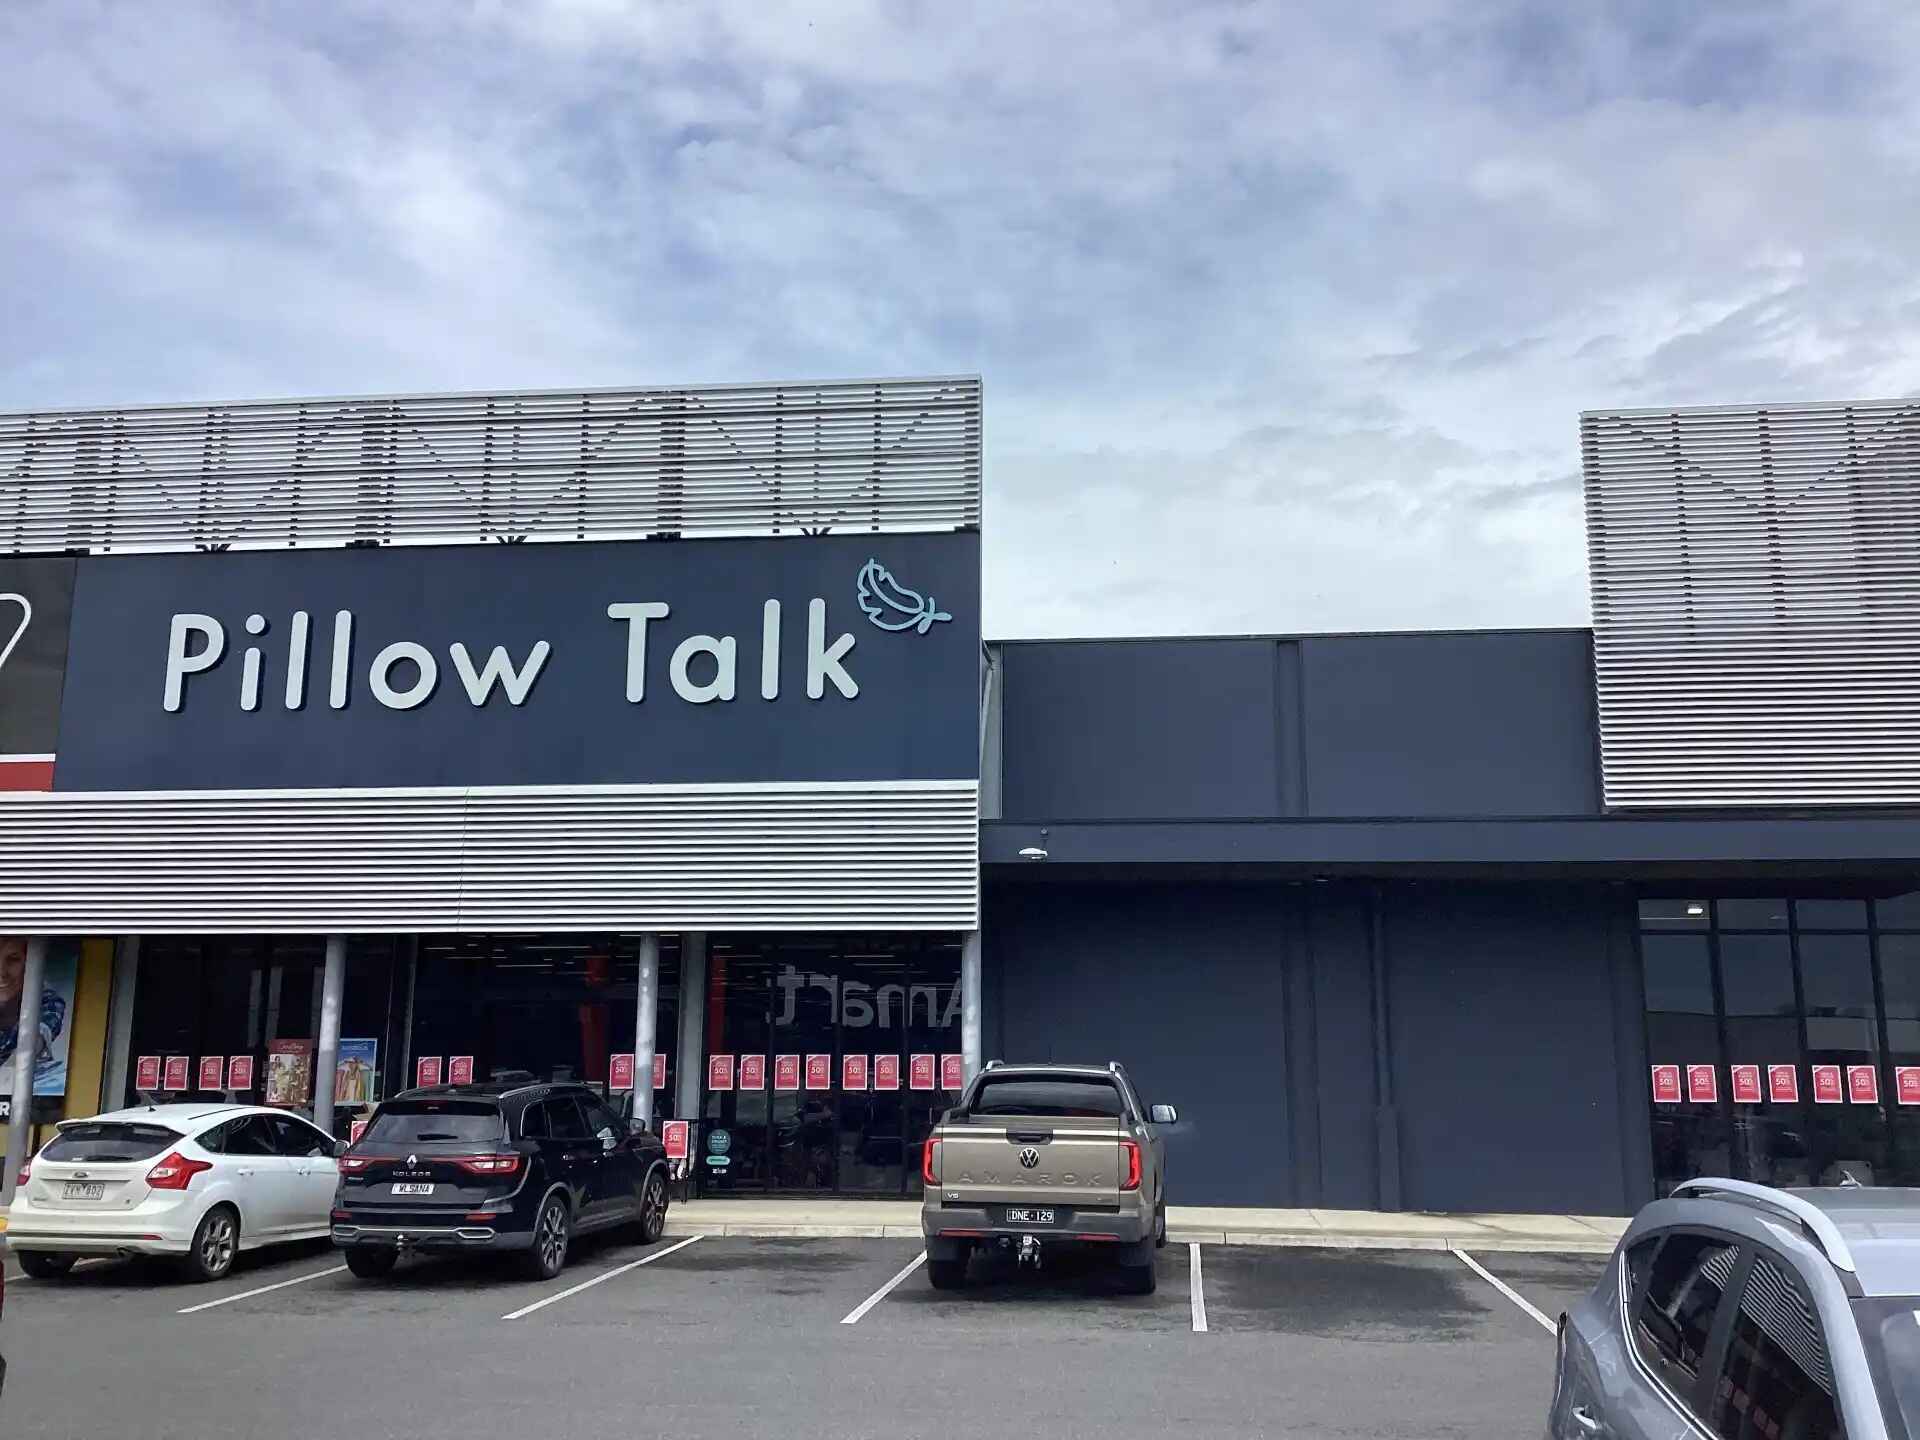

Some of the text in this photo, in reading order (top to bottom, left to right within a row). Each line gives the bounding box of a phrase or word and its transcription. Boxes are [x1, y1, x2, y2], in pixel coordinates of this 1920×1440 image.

[163, 598, 859, 712] Pillow Talk
[958, 1171, 1103, 1186] AMAROK
[1011, 1210, 1053, 1221] DNE 129
